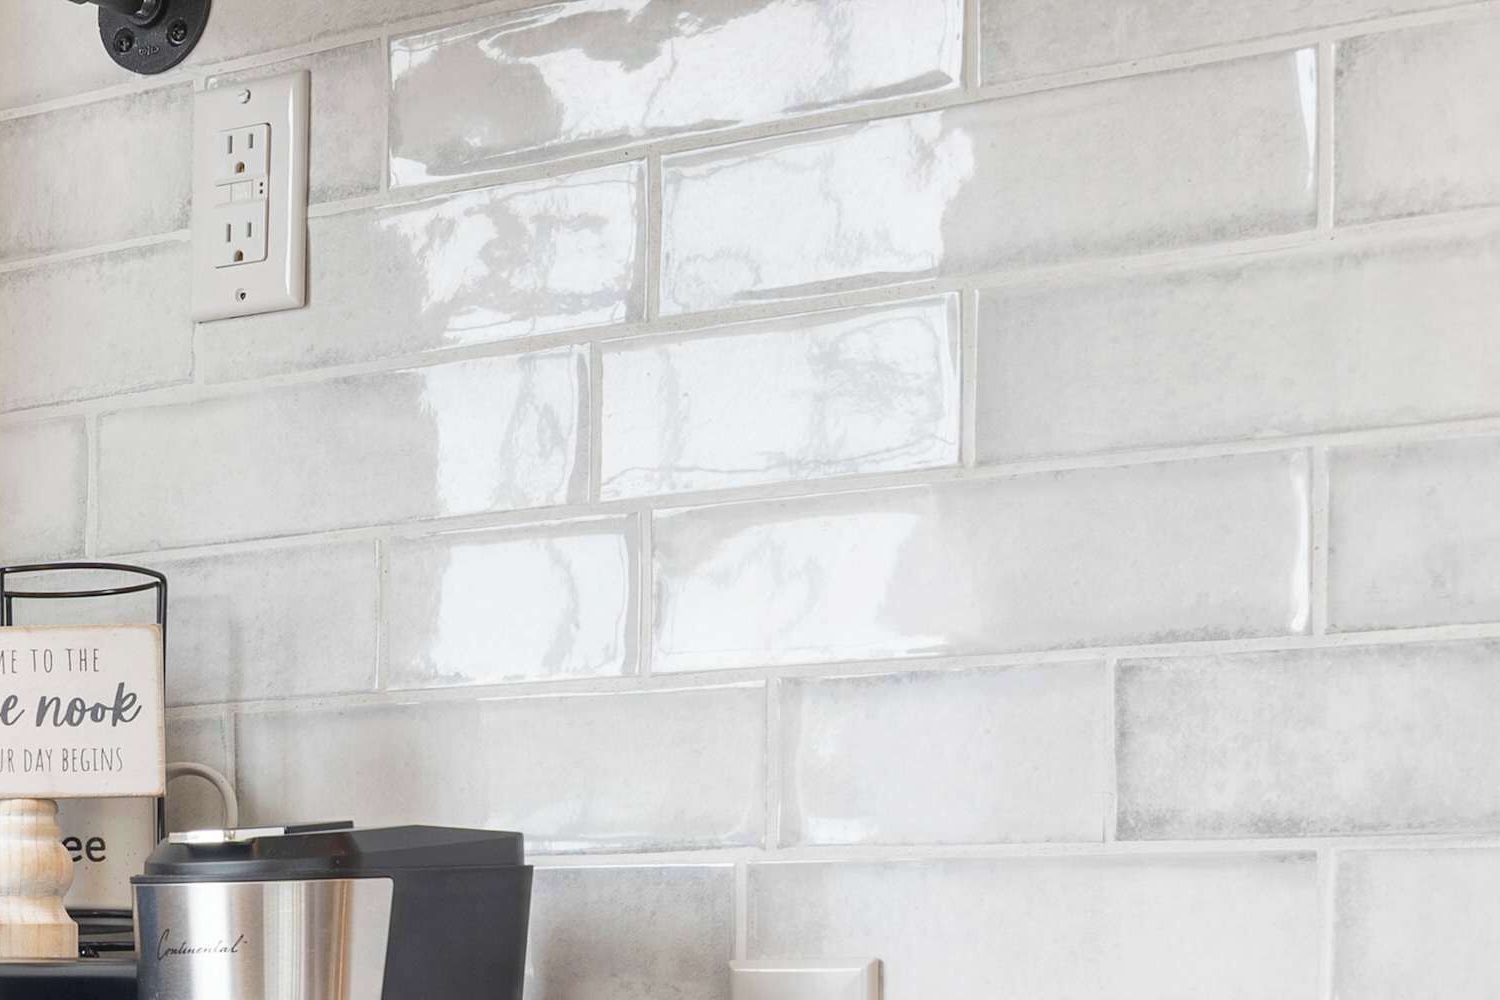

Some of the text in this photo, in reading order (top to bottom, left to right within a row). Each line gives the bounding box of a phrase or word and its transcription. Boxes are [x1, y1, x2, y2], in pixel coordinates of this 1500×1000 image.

[30, 648, 53, 673] TO
[65, 647, 100, 673] THE
[35, 682, 142, 727] nook
[23, 748, 53, 773] DAY
[61, 746, 124, 773] BEGINS
